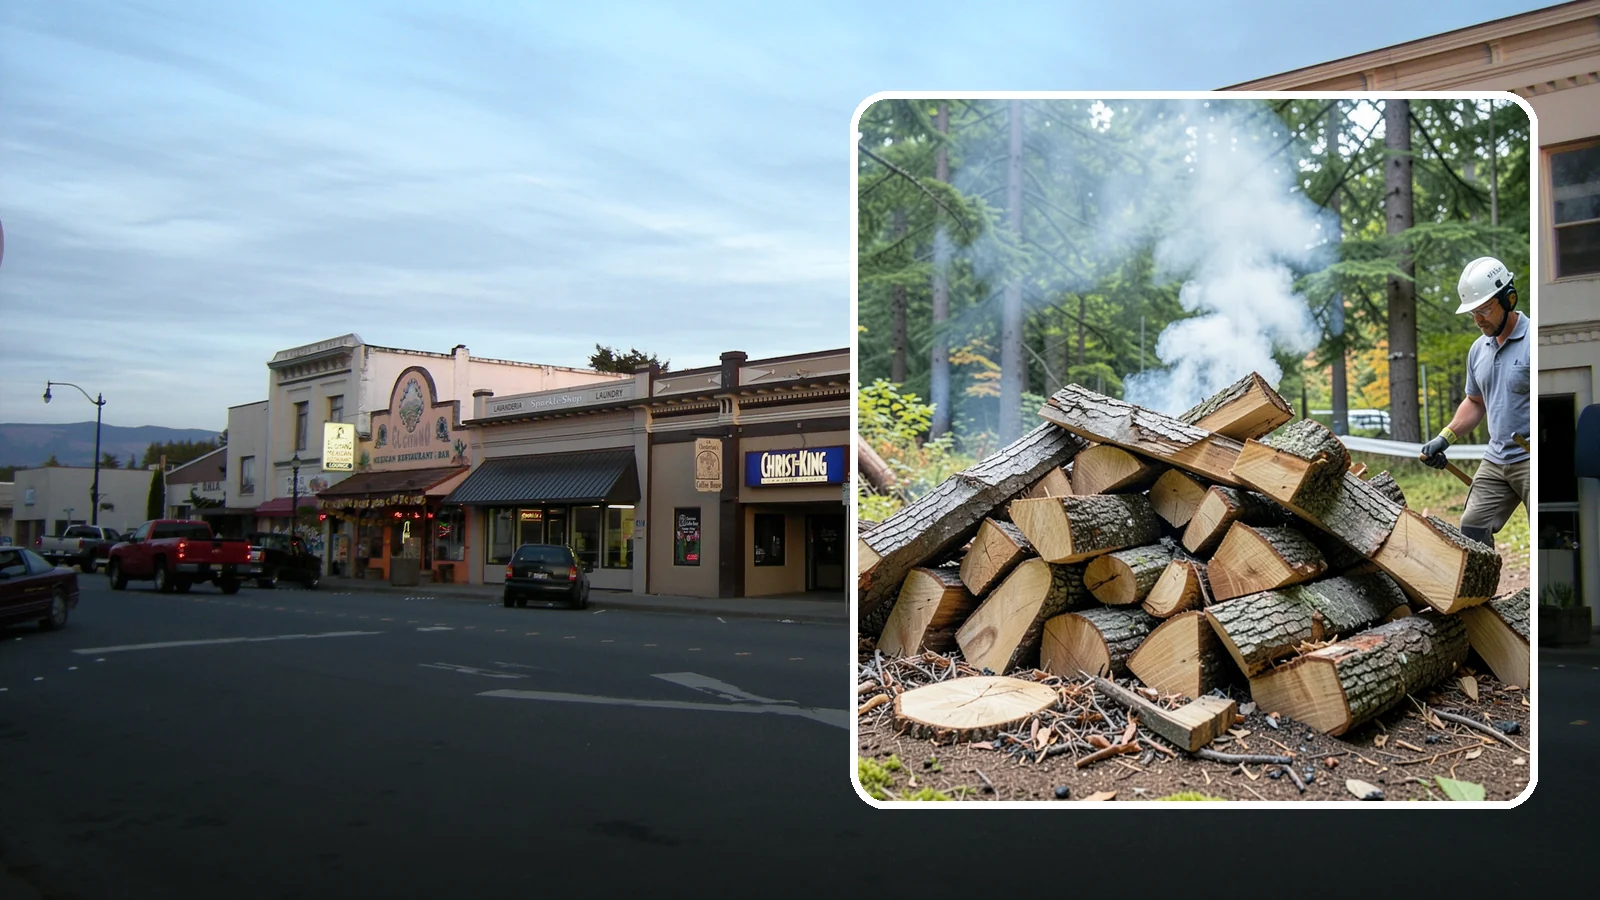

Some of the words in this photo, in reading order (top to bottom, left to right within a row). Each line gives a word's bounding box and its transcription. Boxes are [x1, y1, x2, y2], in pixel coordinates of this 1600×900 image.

[531, 396, 561, 408] Sparkle
[562, 394, 582, 404] Shop
[595, 389, 624, 400] LAUNDRY
[493, 403, 523, 412] LAVANDERIA
[373, 455, 396, 465] MEXICAN
[397, 451, 433, 462] RESTAURANT
[438, 450, 450, 459] BAR
[761, 451, 798, 478] CHRIST
[799, 450, 828, 476] KING
